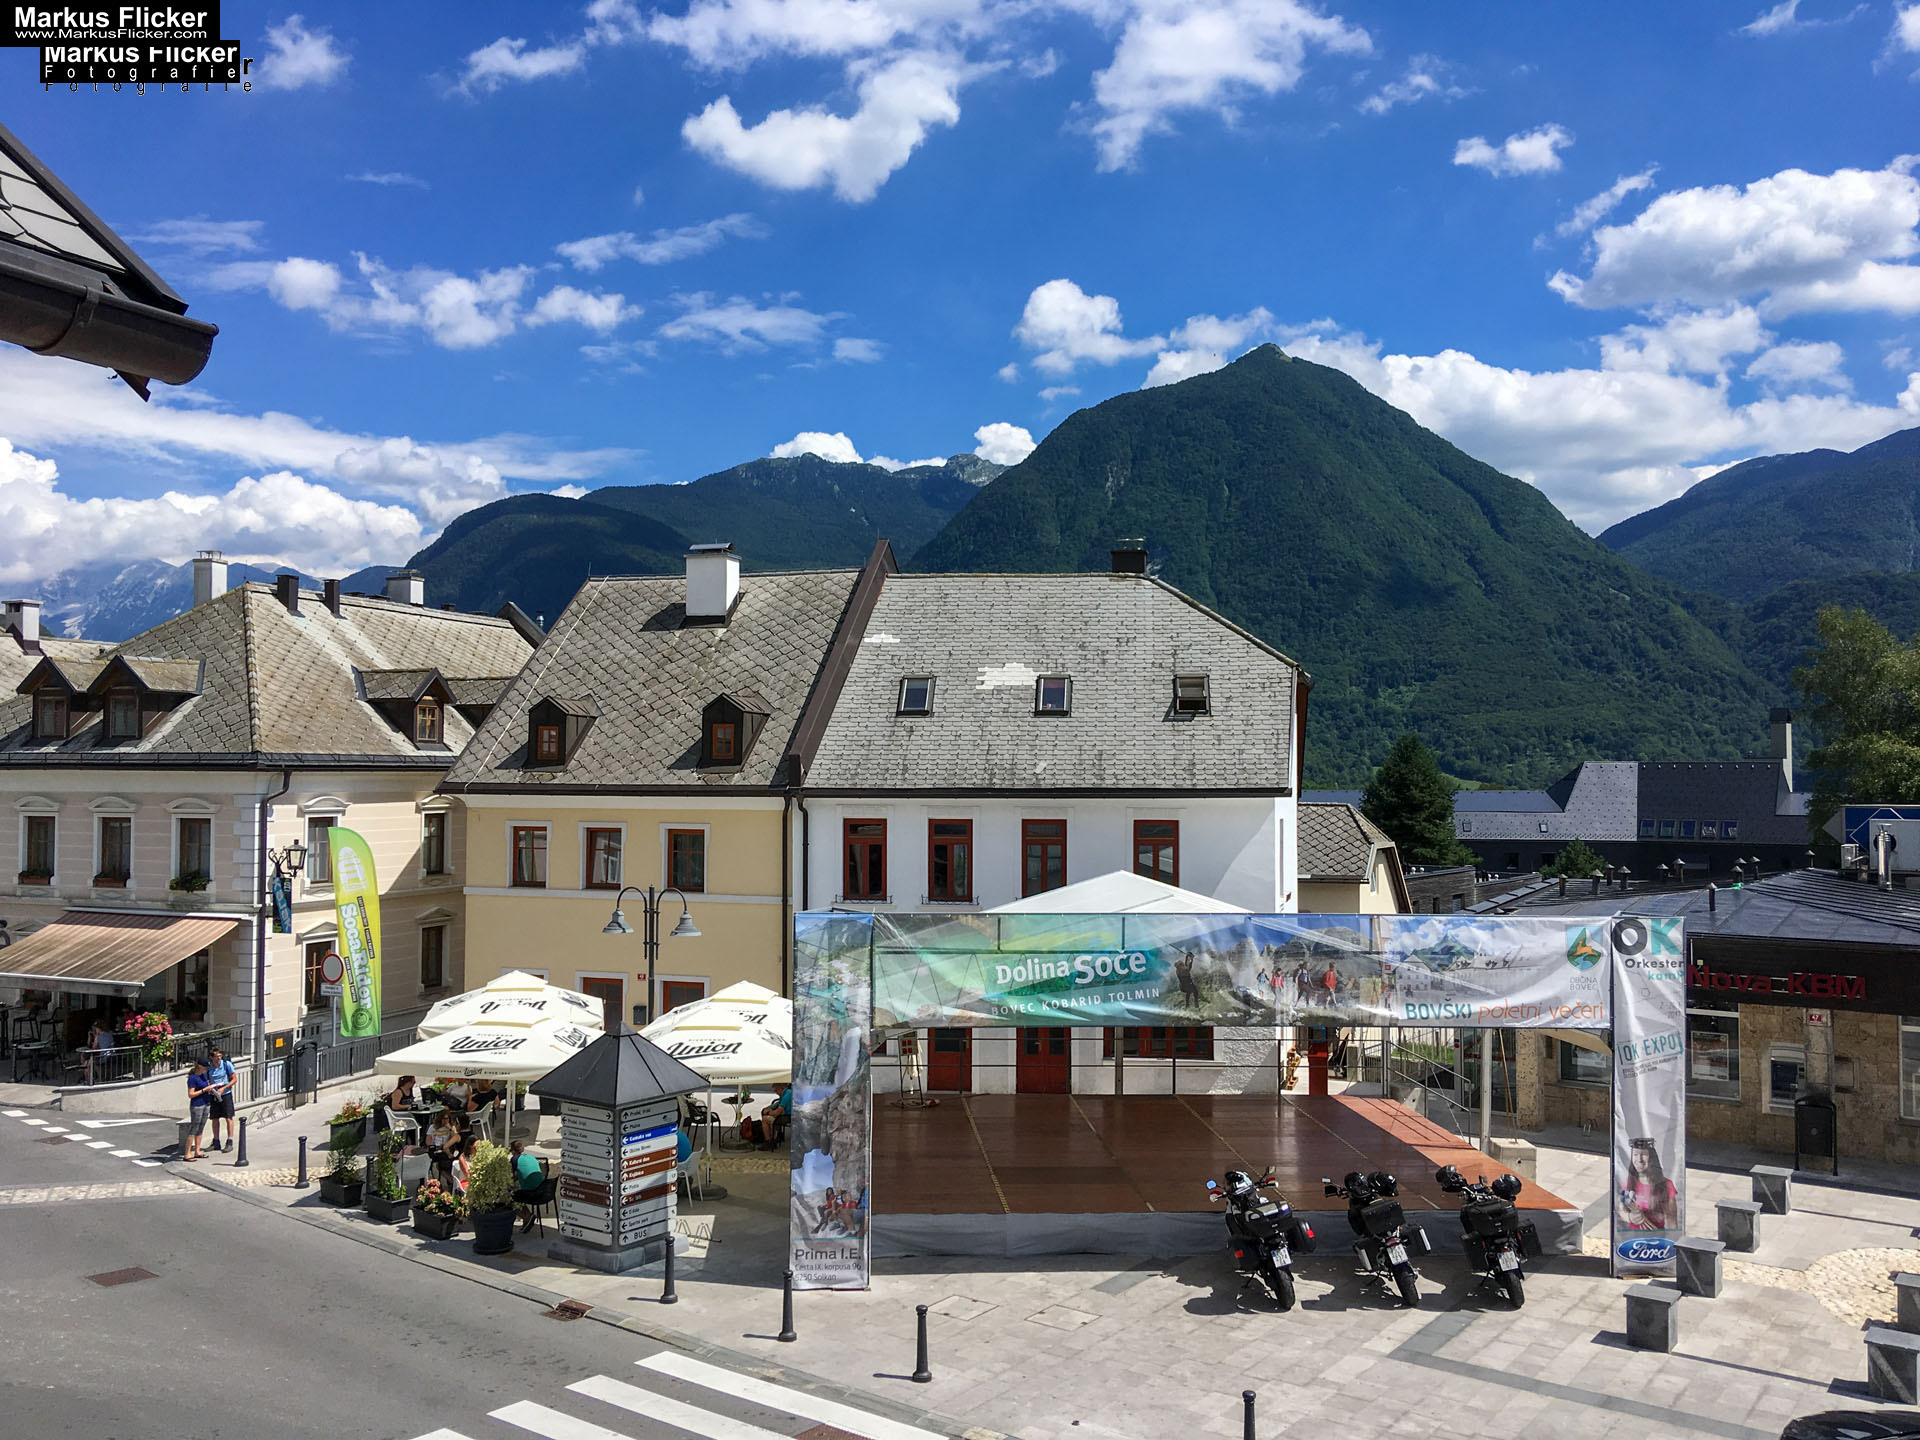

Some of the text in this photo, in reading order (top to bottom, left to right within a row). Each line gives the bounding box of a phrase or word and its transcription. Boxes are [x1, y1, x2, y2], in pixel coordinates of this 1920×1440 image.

[996, 948, 1147, 984] Dolina Soče
[1625, 959, 1684, 968] Orkester
[1687, 965, 1867, 1000] Nova KBM
[992, 988, 1160, 1015] BOVEC KOBARID TOLMIN
[1406, 998, 1604, 1024] BOVŠKI poletni večeri
[449, 1036, 528, 1052] Union
[667, 1041, 742, 1057] Union
[1623, 1034, 1677, 1062] OK EXPO
[571, 1228, 583, 1237] BUS
[634, 1230, 647, 1239] BUS
[795, 1248, 862, 1260] Prima I.E.
[1629, 1240, 1670, 1259] Ford
